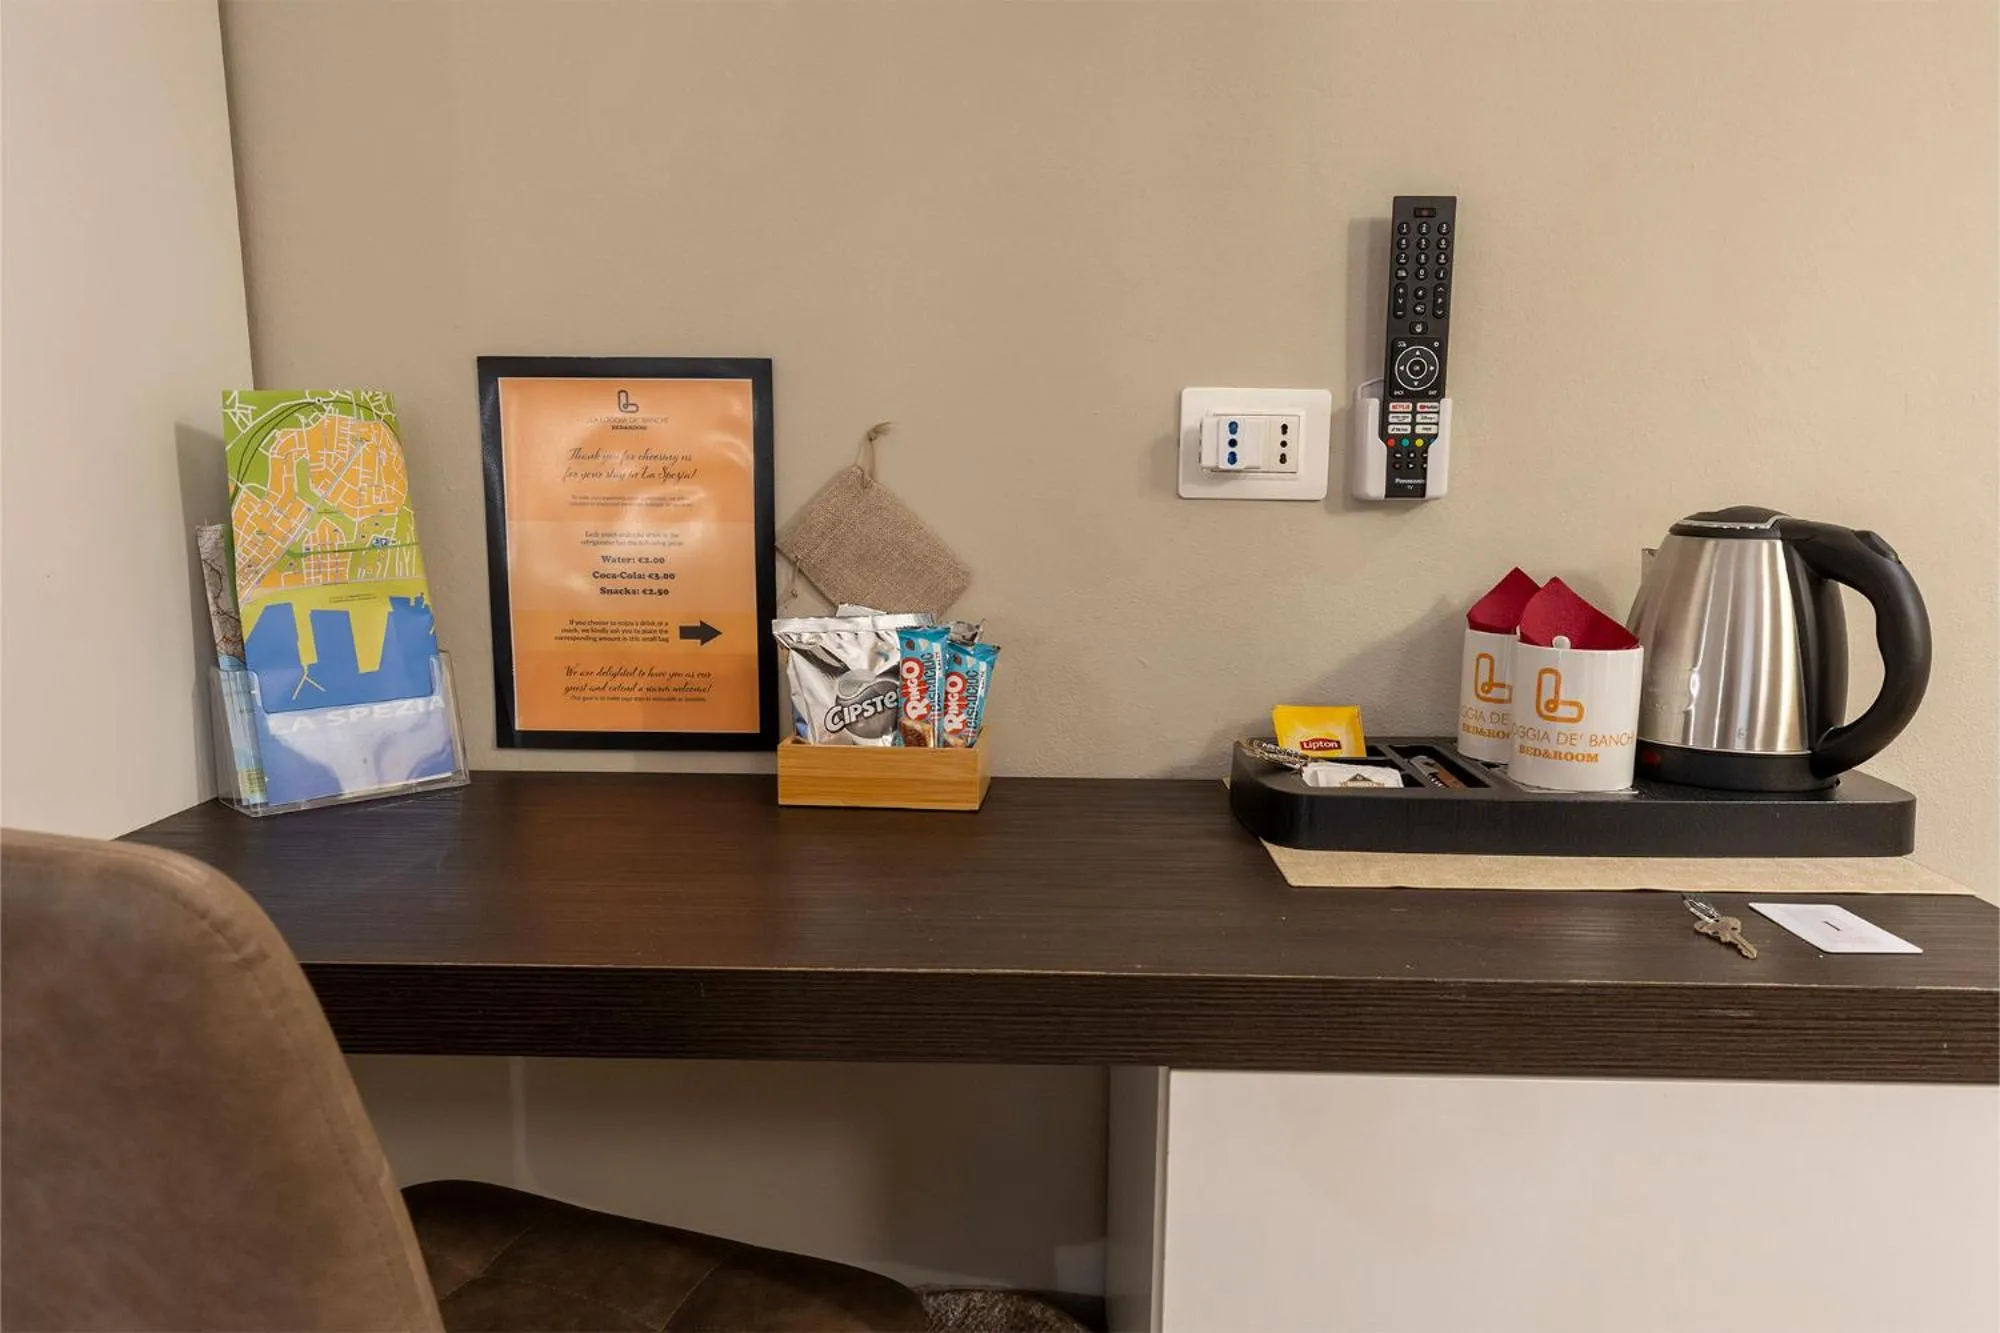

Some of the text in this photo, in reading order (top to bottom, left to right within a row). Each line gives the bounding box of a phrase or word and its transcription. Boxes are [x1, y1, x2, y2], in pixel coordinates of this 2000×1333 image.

[568, 447, 601, 460] Thank
[638, 447, 679, 466] choosing
[640, 465, 656, 480] La
[601, 555, 636, 564] Water:
[592, 570, 646, 580] Coca-Cola:
[599, 586, 670, 597] Snacks: €2.50
[564, 665, 577, 677] We
[579, 669, 594, 677] are
[596, 665, 637, 682] delighted
[647, 665, 666, 678] have
[669, 671, 683, 682] you
[563, 684, 588, 695] guest
[589, 681, 607, 692] and
[609, 681, 638, 692] extend
[672, 681, 713, 693] welcome!
[901, 660, 931, 721] RINGO
[327, 695, 447, 727] SPEZIA
[943, 674, 966, 732] RINGO
[1462, 722, 1510, 740] BED&RO
[1556, 731, 1583, 746] DE'
[1302, 740, 1339, 750] Lipton
[1518, 744, 1599, 763] BED&ROOM
